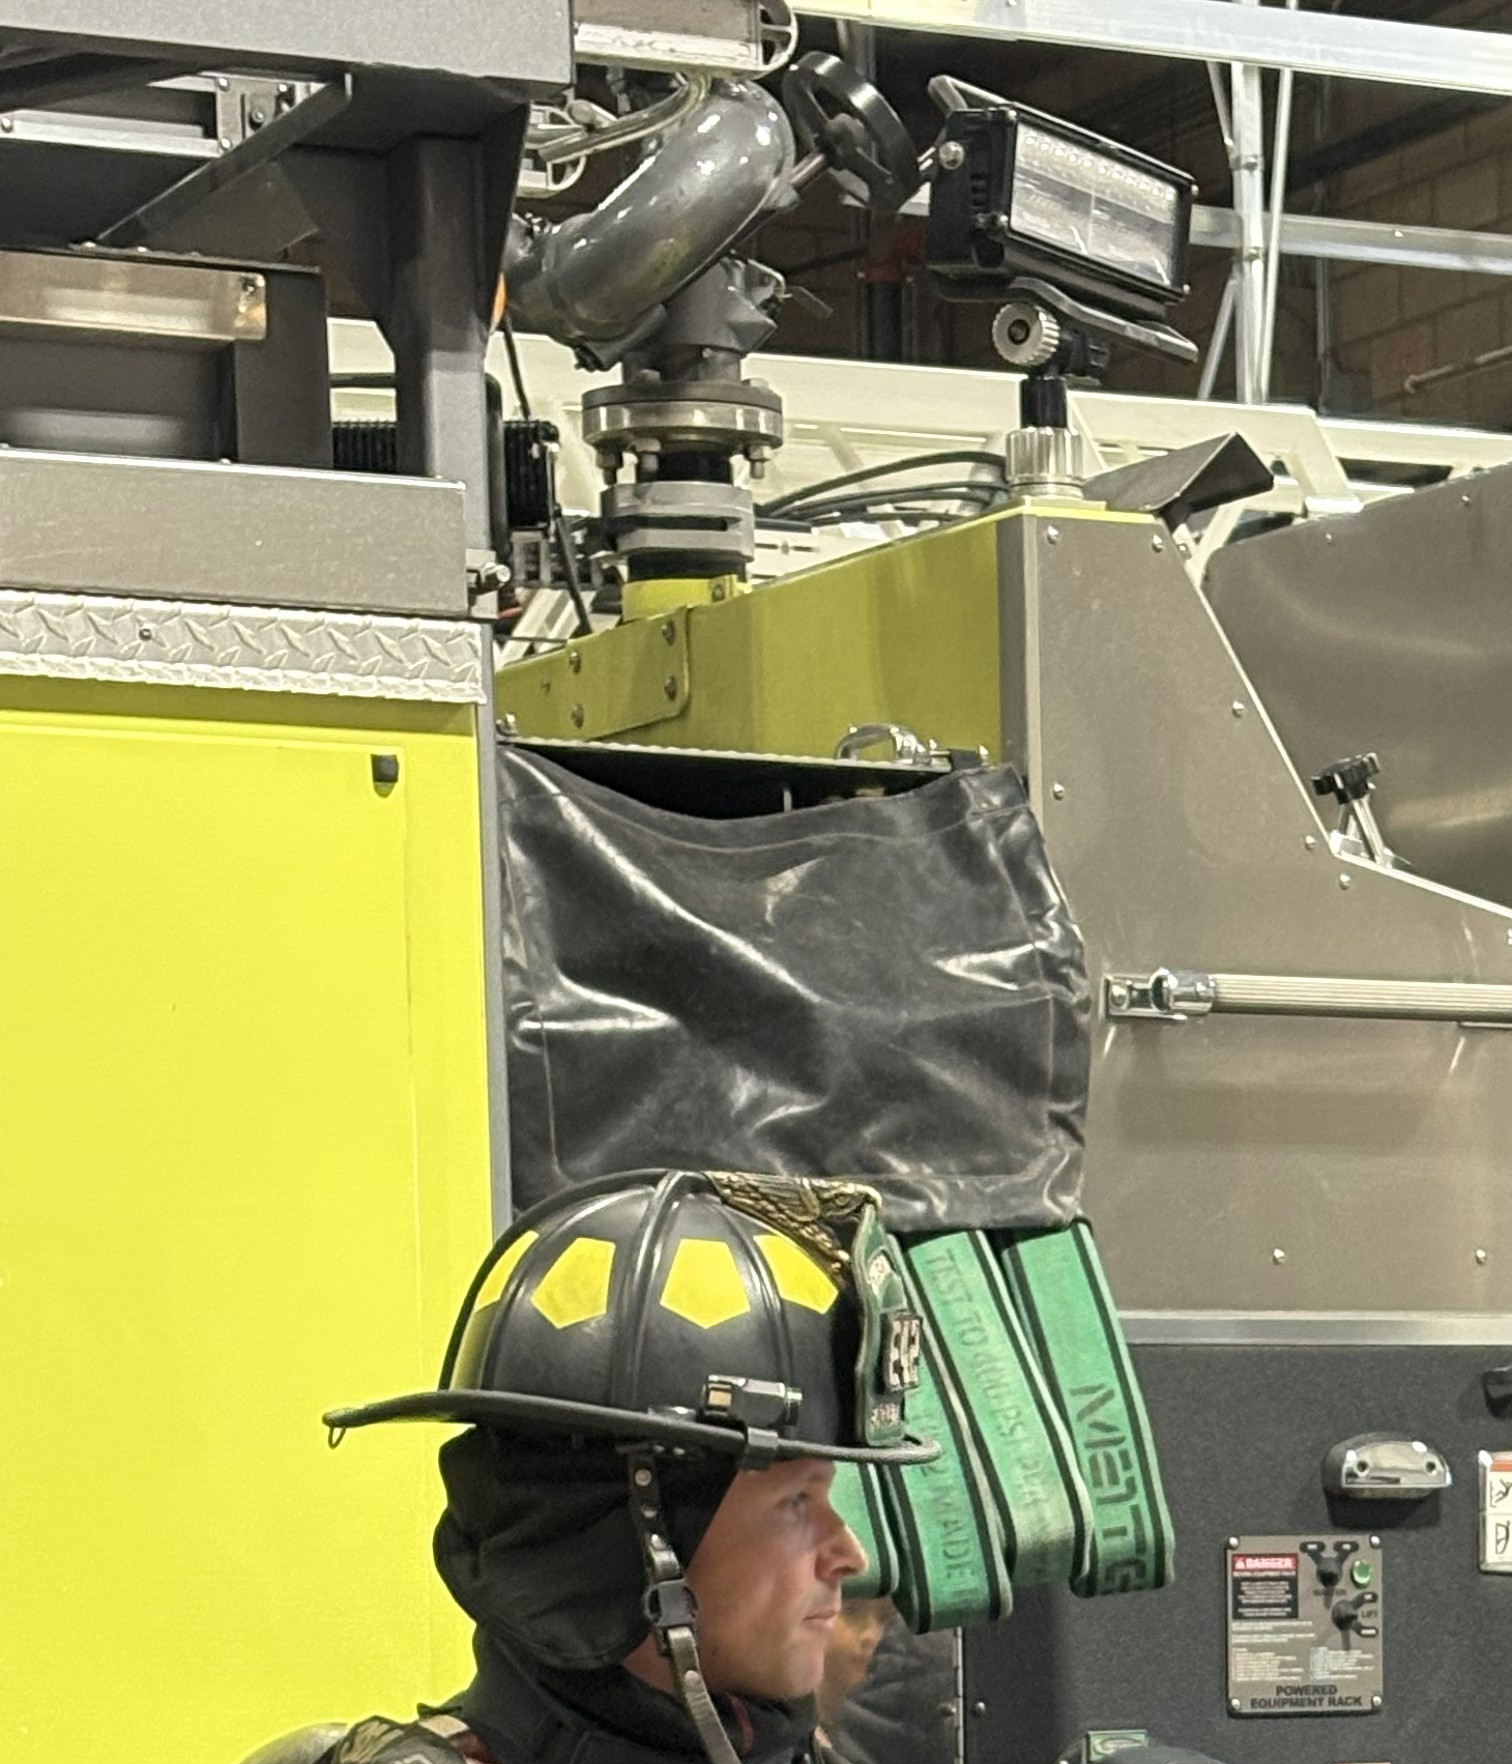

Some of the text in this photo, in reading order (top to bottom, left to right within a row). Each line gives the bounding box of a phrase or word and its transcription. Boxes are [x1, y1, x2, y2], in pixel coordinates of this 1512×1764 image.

[1275, 1684, 1338, 1696] POWERED
[1250, 1695, 1362, 1709] EQUIPMENT RACK
